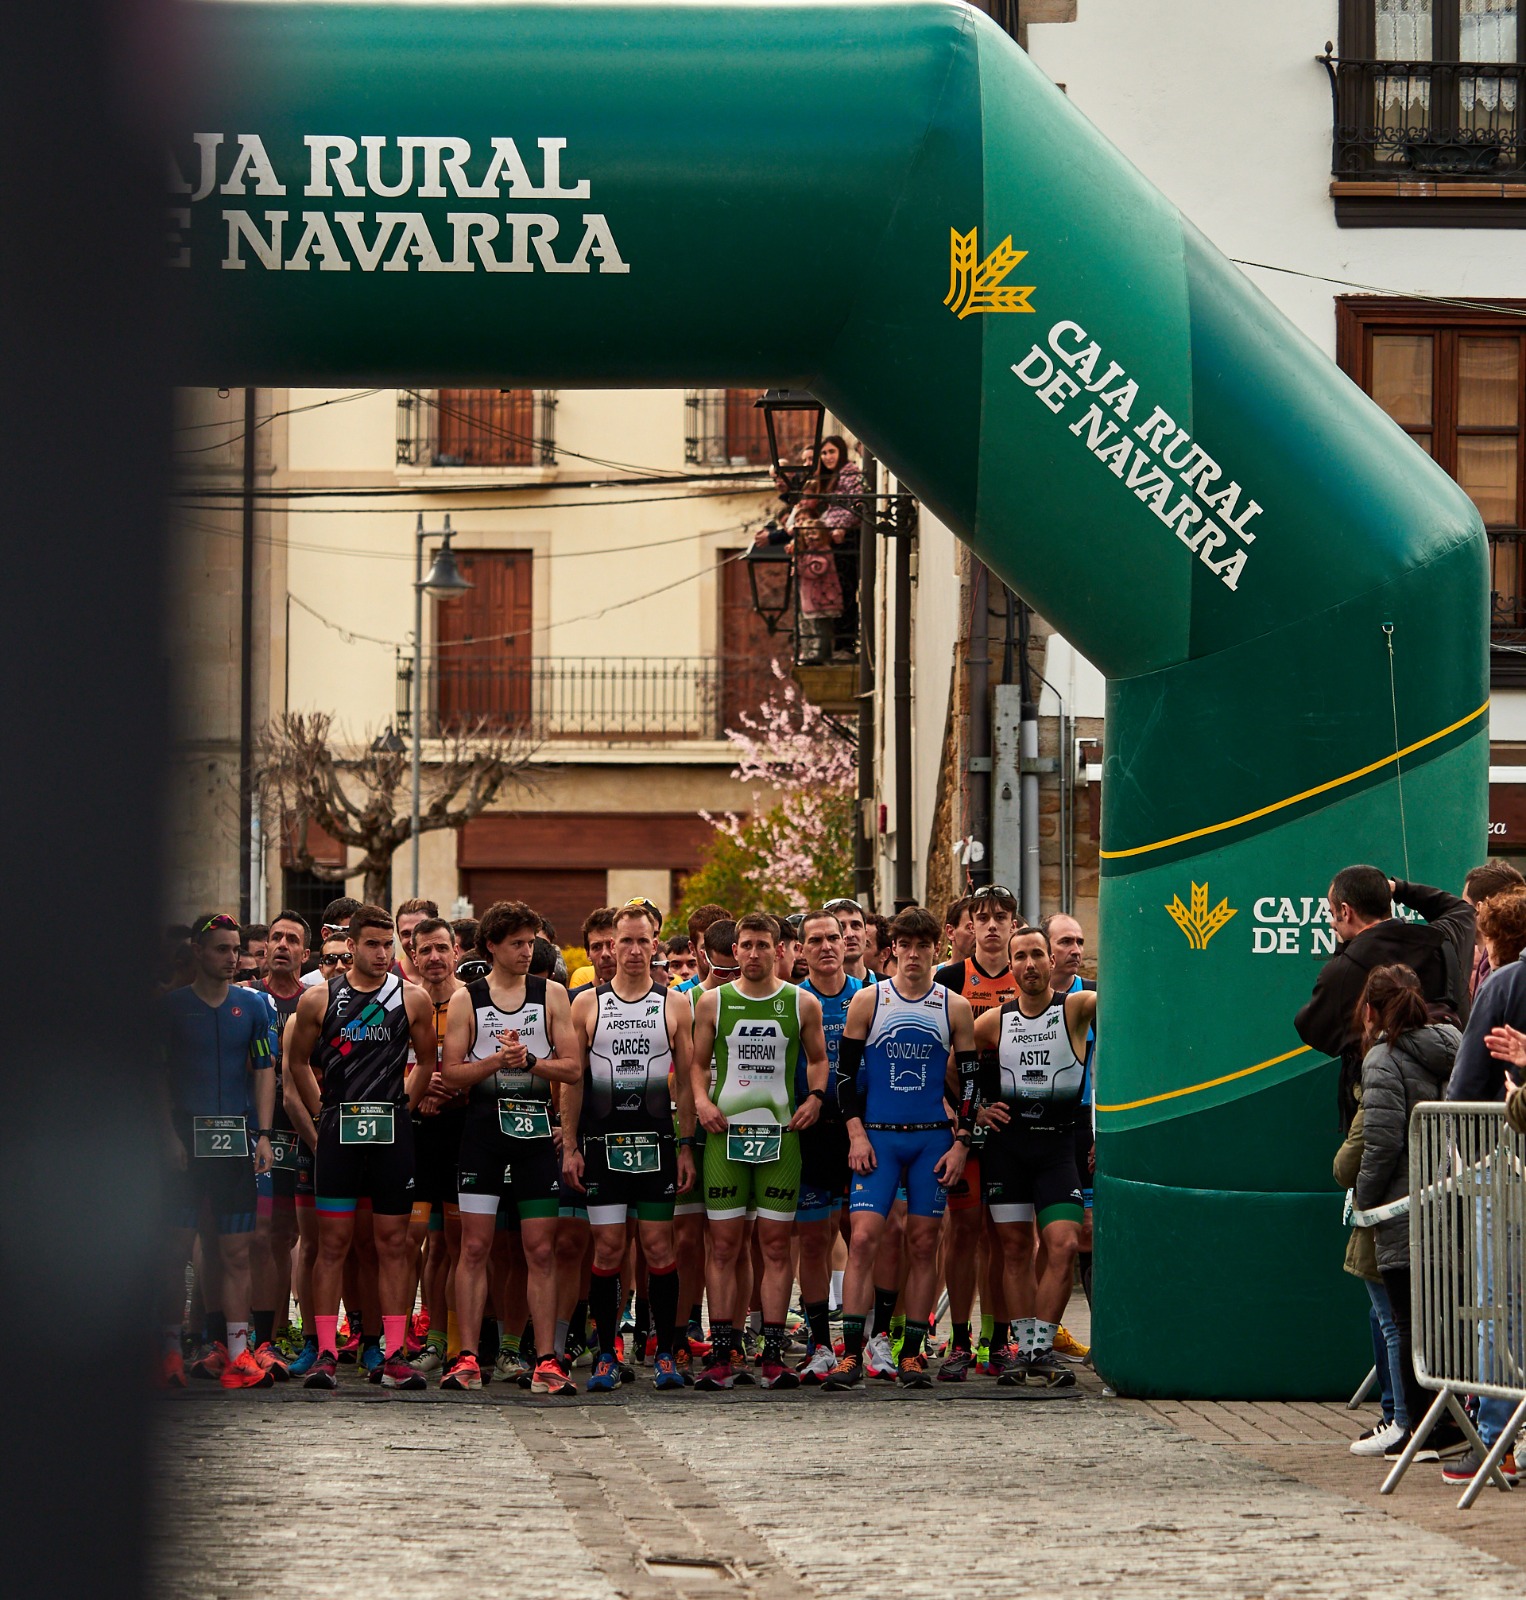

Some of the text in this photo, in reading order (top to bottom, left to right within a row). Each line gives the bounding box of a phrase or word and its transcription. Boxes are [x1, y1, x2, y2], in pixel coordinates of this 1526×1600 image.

[303, 134, 591, 200] RURAL
[221, 209, 631, 274] NAVARRA
[1047, 319, 1265, 547] CAJA RURAL
[1010, 343, 1249, 592] DE NAVARRA
[1253, 897, 1334, 926] CAJA
[1252, 927, 1300, 954] DE
[738, 1026, 777, 1038] LEA
[612, 1034, 651, 1056] GARCÉS
[738, 1044, 776, 1060] HERRAN
[886, 1041, 933, 1060] GONZALEZ
[1019, 1050, 1051, 1066] ASTIZ
[893, 1085, 922, 1093] mugarra
[357, 1120, 377, 1137] 51
[515, 1117, 534, 1132] 28
[211, 1134, 232, 1150] 22
[744, 1140, 766, 1157] 27
[623, 1150, 642, 1167] 31
[708, 1186, 796, 1200] BH BH
